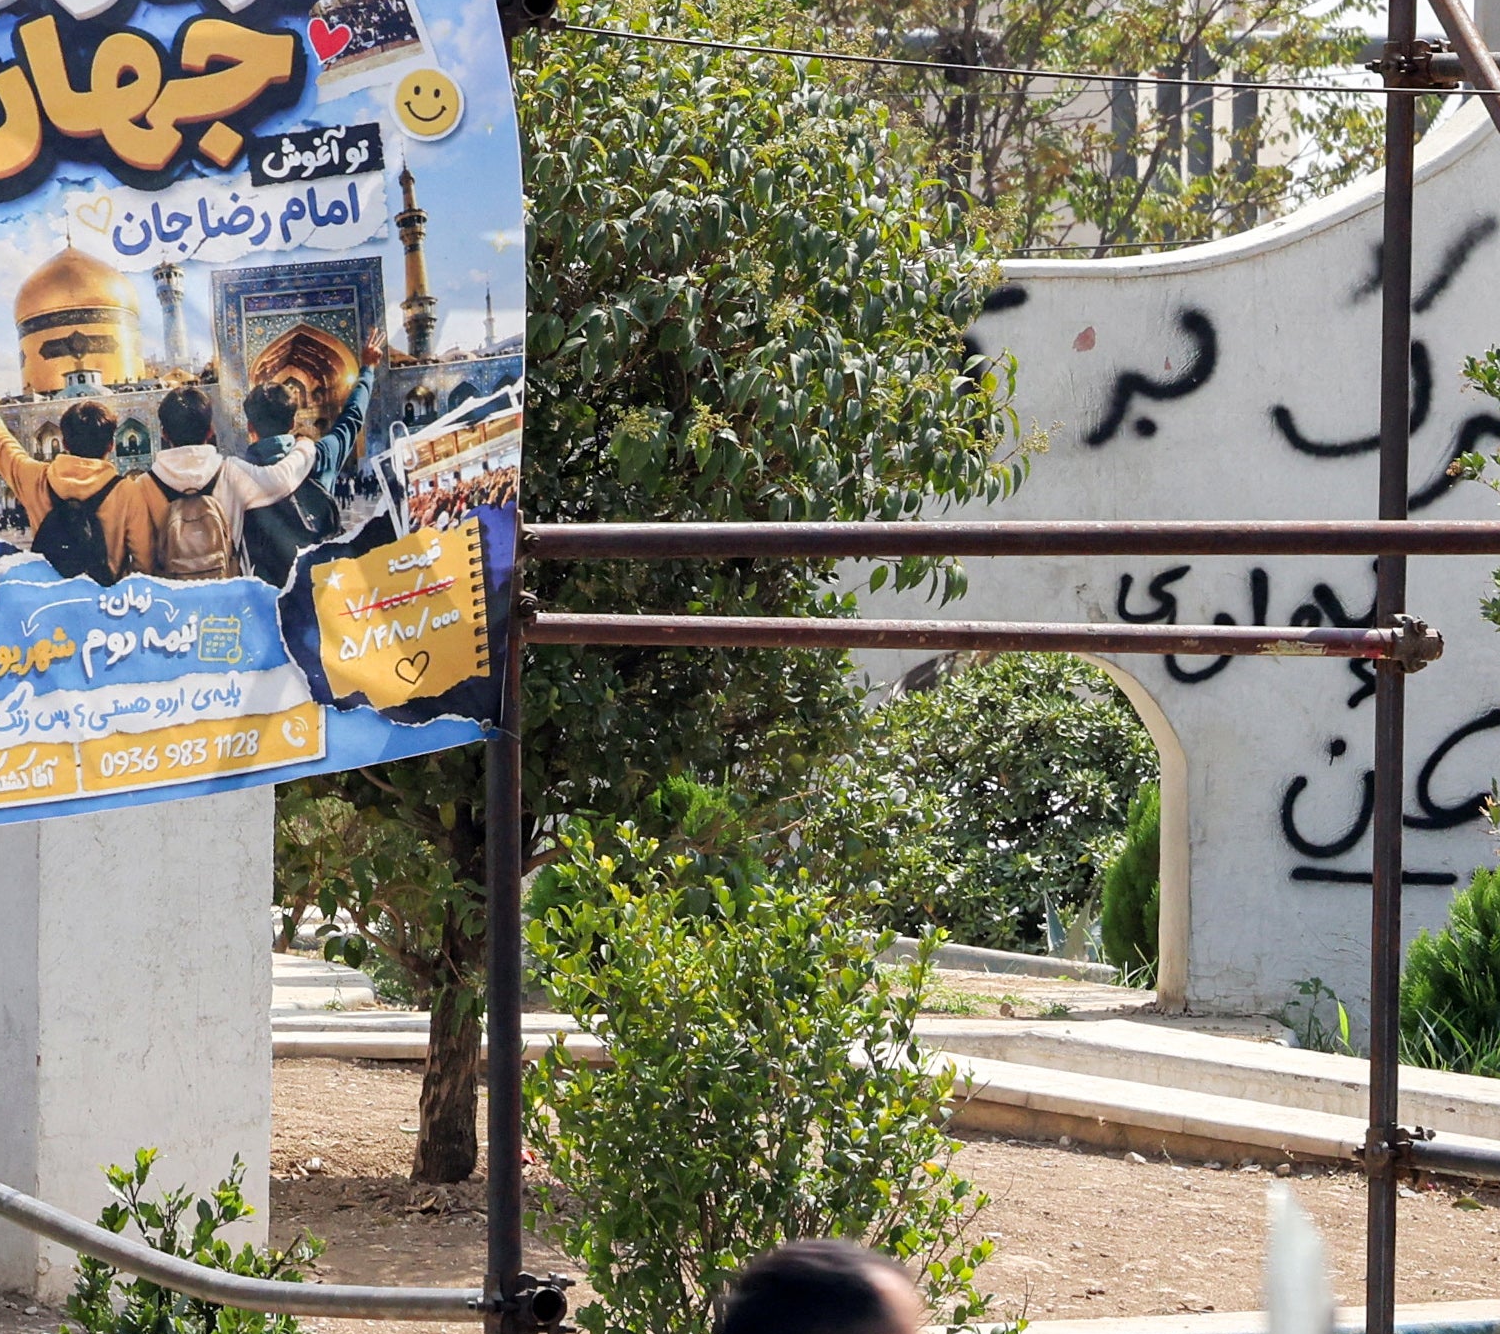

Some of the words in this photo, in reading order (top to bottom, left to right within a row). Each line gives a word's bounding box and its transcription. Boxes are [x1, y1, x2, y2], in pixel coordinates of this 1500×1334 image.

[261, 124, 347, 179] آغوش
[345, 139, 369, 175] تو
[111, 200, 193, 257] جان
[197, 191, 273, 247] رضا
[279, 181, 361, 243] امام
[1084, 304, 1218, 447] بر
[387, 537, 442, 574] قیمت:
[99, 584, 153, 617] زمان:
[81, 627, 137, 679] دوم
[143, 614, 199, 652] نیمه
[35, 708, 71, 731] پس
[154, 687, 184, 718] اردو
[100, 743, 158, 777] 0936
[164, 735, 207, 769] 983
[214, 728, 259, 759] 1128
